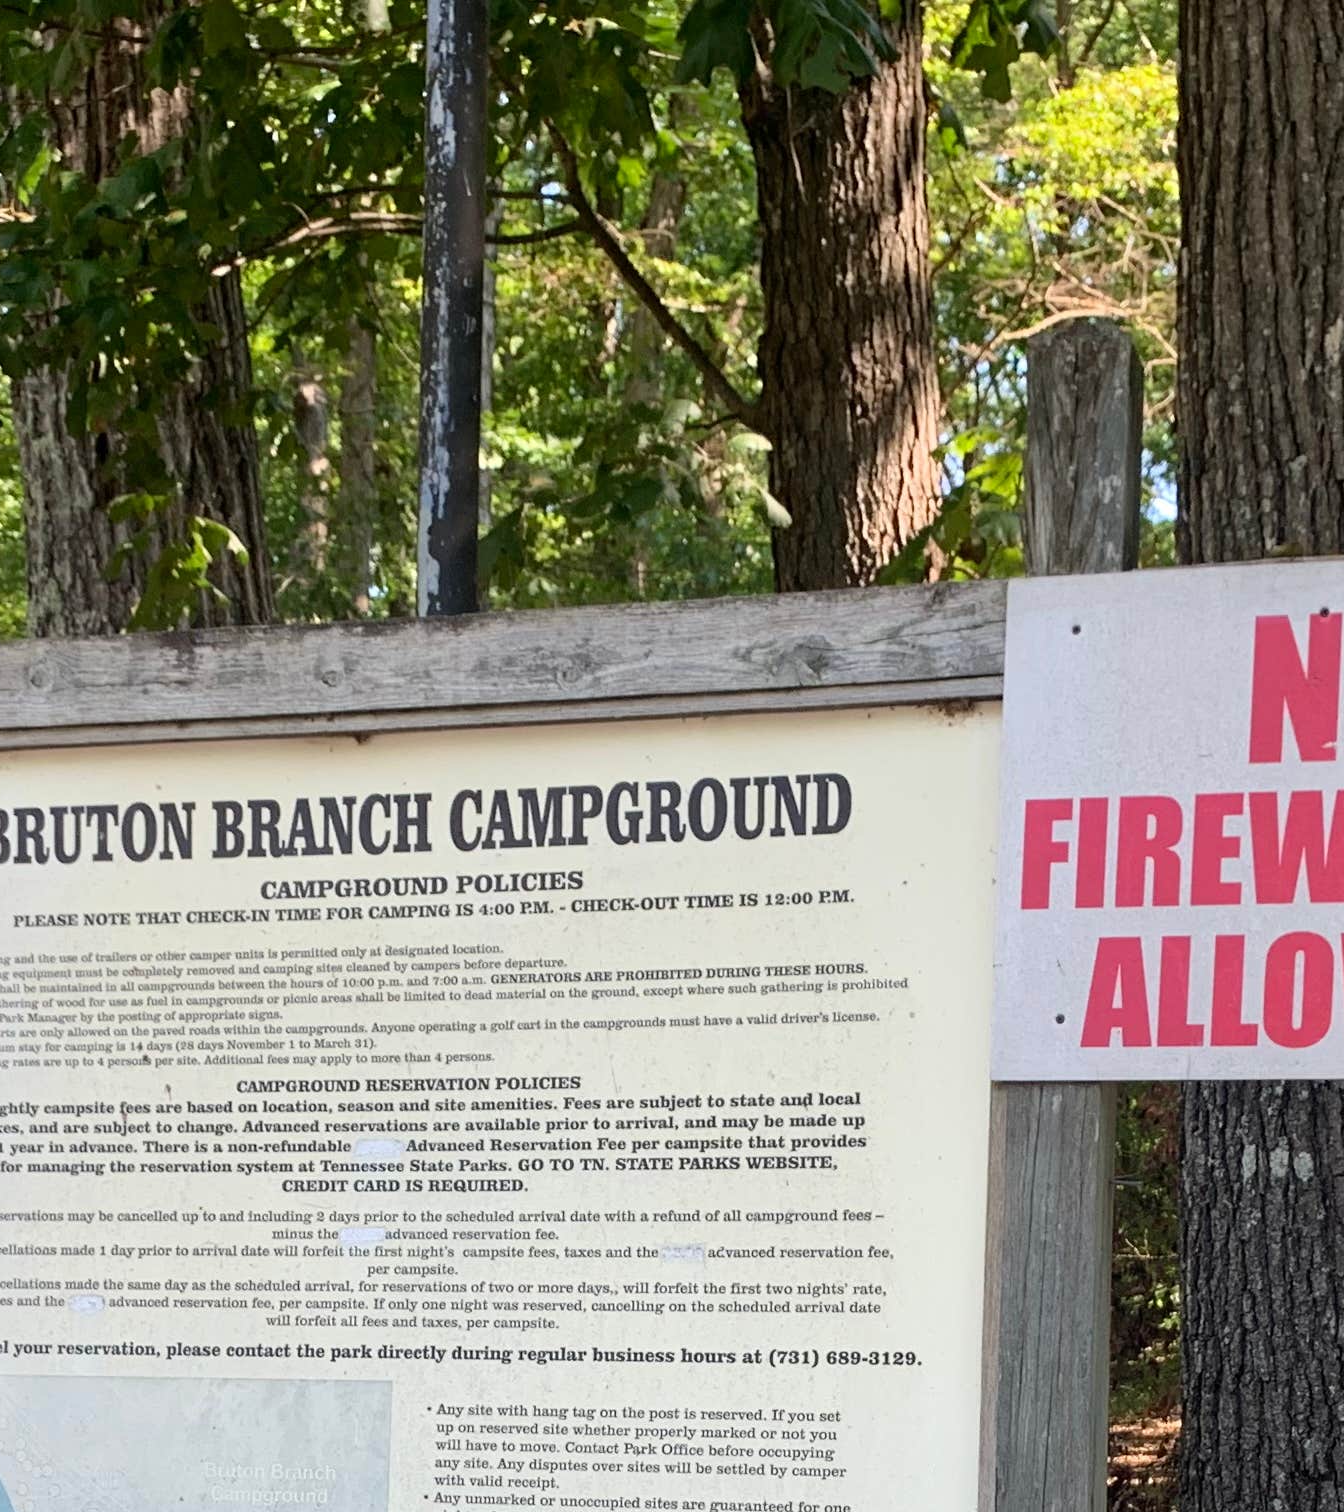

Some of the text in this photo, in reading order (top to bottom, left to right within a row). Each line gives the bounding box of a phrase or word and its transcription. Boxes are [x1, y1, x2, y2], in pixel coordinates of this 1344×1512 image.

[211, 793, 432, 858] BRANCH
[449, 774, 852, 849] CAMPGROUND
[260, 871, 583, 899] CAMPGROUND POLICIES
[13, 914, 78, 927] PLEASE
[83, 913, 130, 925] NOTE
[135, 911, 181, 924] THAT
[186, 909, 270, 923] CHECK-IN
[274, 908, 321, 921] TIME
[326, 906, 363, 920] FOR
[368, 904, 450, 919] CAMPING
[455, 903, 474, 916] IS
[478, 903, 515, 915] 4:00
[519, 900, 554, 914] P.M.
[570, 896, 679, 912] CHECK-OUT
[684, 894, 733, 908] TIME
[738, 893, 758, 907] IS
[764, 892, 813, 906] 12:00
[818, 889, 854, 903] P.M.
[236, 1076, 581, 1093] CAMPGROUND RESERVATION POLICIES
[281, 1179, 528, 1192] CREDIT CARD IS REQUIRED.
[12, 1344, 52, 1357] your
[57, 1342, 160, 1356] reservation,
[166, 1342, 221, 1359] please
[226, 1343, 291, 1357] contact
[296, 1343, 325, 1358] the
[330, 1344, 372, 1362] park
[377, 1344, 447, 1363] directly
[451, 1345, 513, 1364] during
[517, 1347, 587, 1365] regular
[591, 1347, 675, 1362] business
[680, 1348, 736, 1363] hours
[742, 1349, 762, 1364] at
[768, 1349, 819, 1368] (731)
[826, 1350, 922, 1365] 689-3129.
[271, 1463, 336, 1481] Branch
